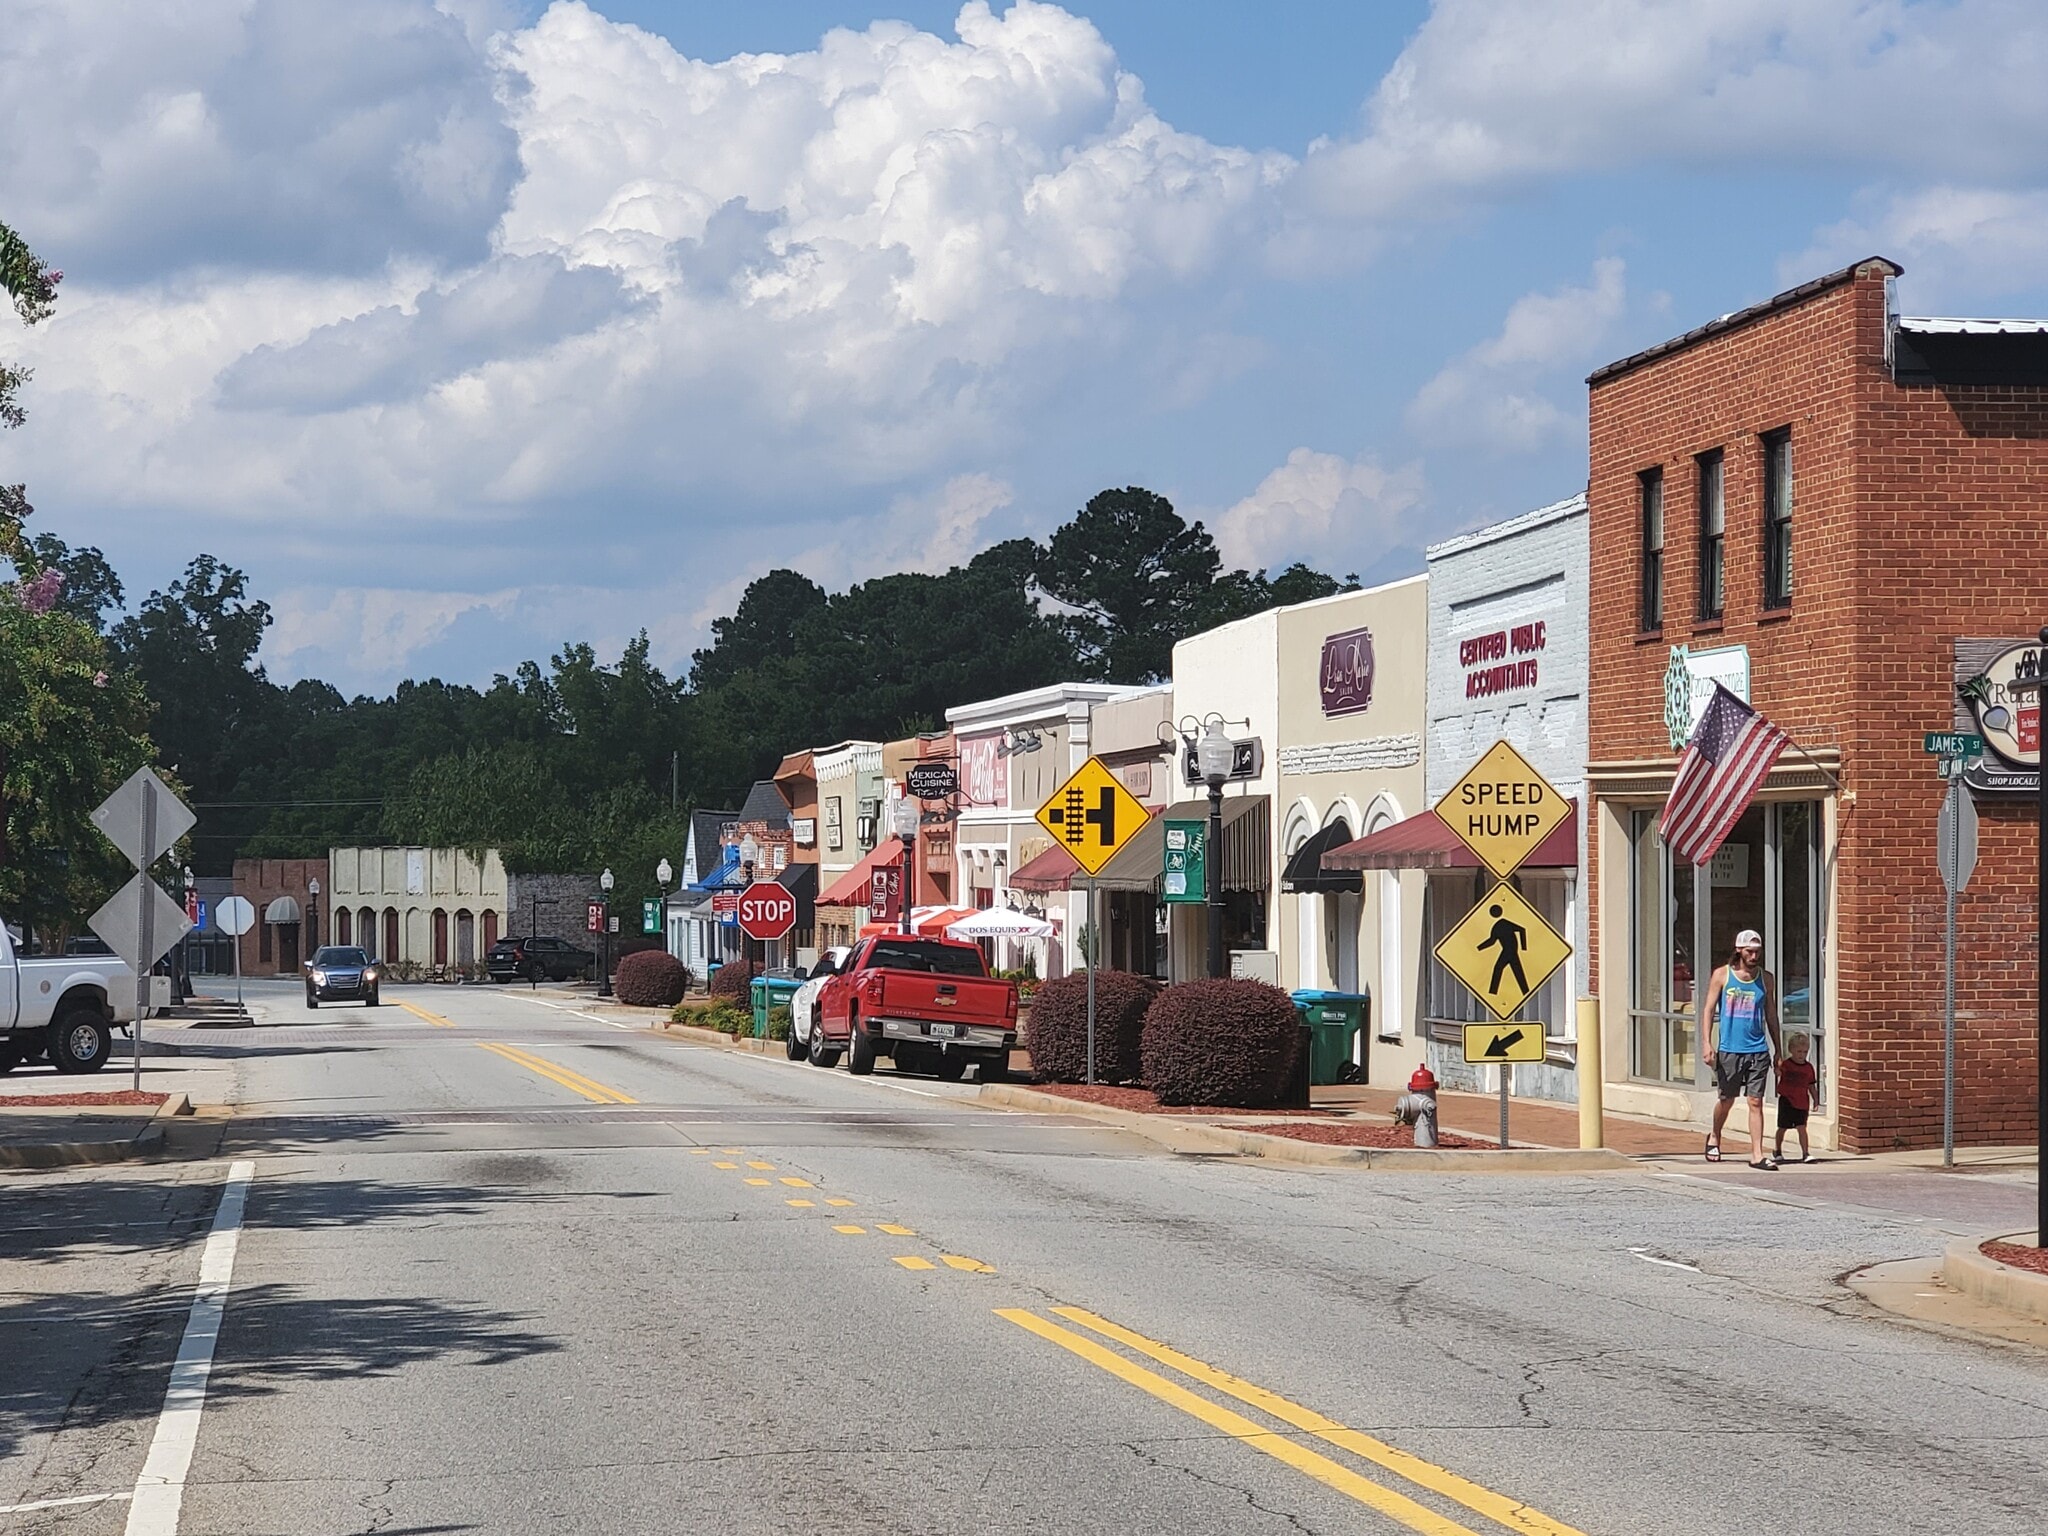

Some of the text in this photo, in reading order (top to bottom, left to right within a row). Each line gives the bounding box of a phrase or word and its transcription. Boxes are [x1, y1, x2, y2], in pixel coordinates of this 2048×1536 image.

[1460, 620, 1546, 668] CERTIFIED PUBLIC
[1466, 658, 1538, 700] ACCOUNTANTS
[1928, 735, 1980, 753] JAMES ST
[908, 771, 955, 780] MEXICAN
[911, 779, 953, 788] CUISINE
[1987, 777, 2008, 786] SHOP
[1461, 783, 1543, 805] SPEED
[1469, 814, 1540, 836] HUMP
[741, 899, 792, 922] STOP
[969, 926, 1031, 934] DOS EQUIS XX
